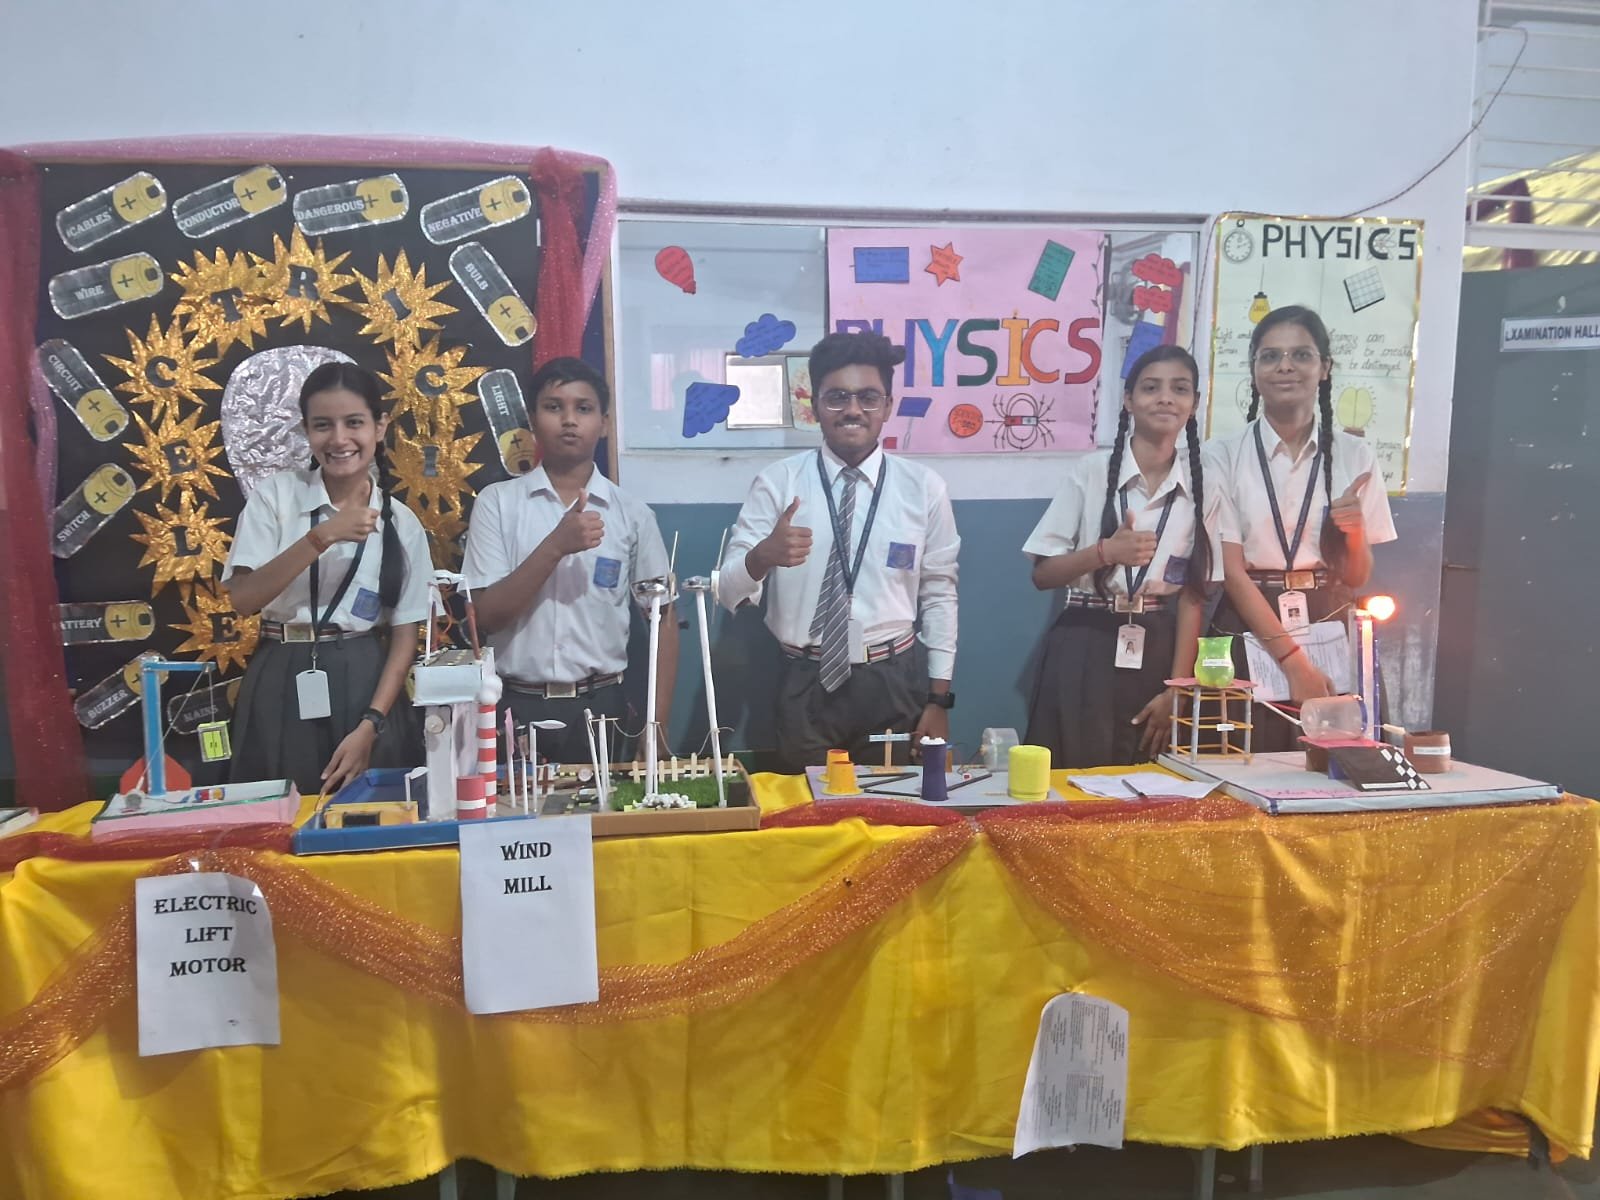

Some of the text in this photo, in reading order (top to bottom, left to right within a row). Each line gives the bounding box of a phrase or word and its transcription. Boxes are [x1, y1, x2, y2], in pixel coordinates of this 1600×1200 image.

[68, 208, 112, 237] CABLES
[177, 198, 240, 231] CONDUCTOR
[296, 199, 365, 221] DANGEROUS
[427, 207, 484, 233] NEGATIVE
[1262, 223, 1416, 260] PHYSICS
[464, 262, 488, 291] BULB
[75, 285, 104, 300] WIRE
[836, 318, 1102, 388] HYSICS
[48, 354, 84, 392] CIRCUIT
[491, 385, 510, 416] LIGHT
[57, 510, 91, 542] SWITCH
[60, 617, 102, 630] ATTERY
[87, 689, 128, 719] BUZZER
[500, 841, 552, 861] WIND
[503, 875, 552, 895] MILL
[154, 895, 257, 915] ELECTRIC
[185, 926, 233, 944] LIFT
[169, 957, 247, 977] MOTOR
